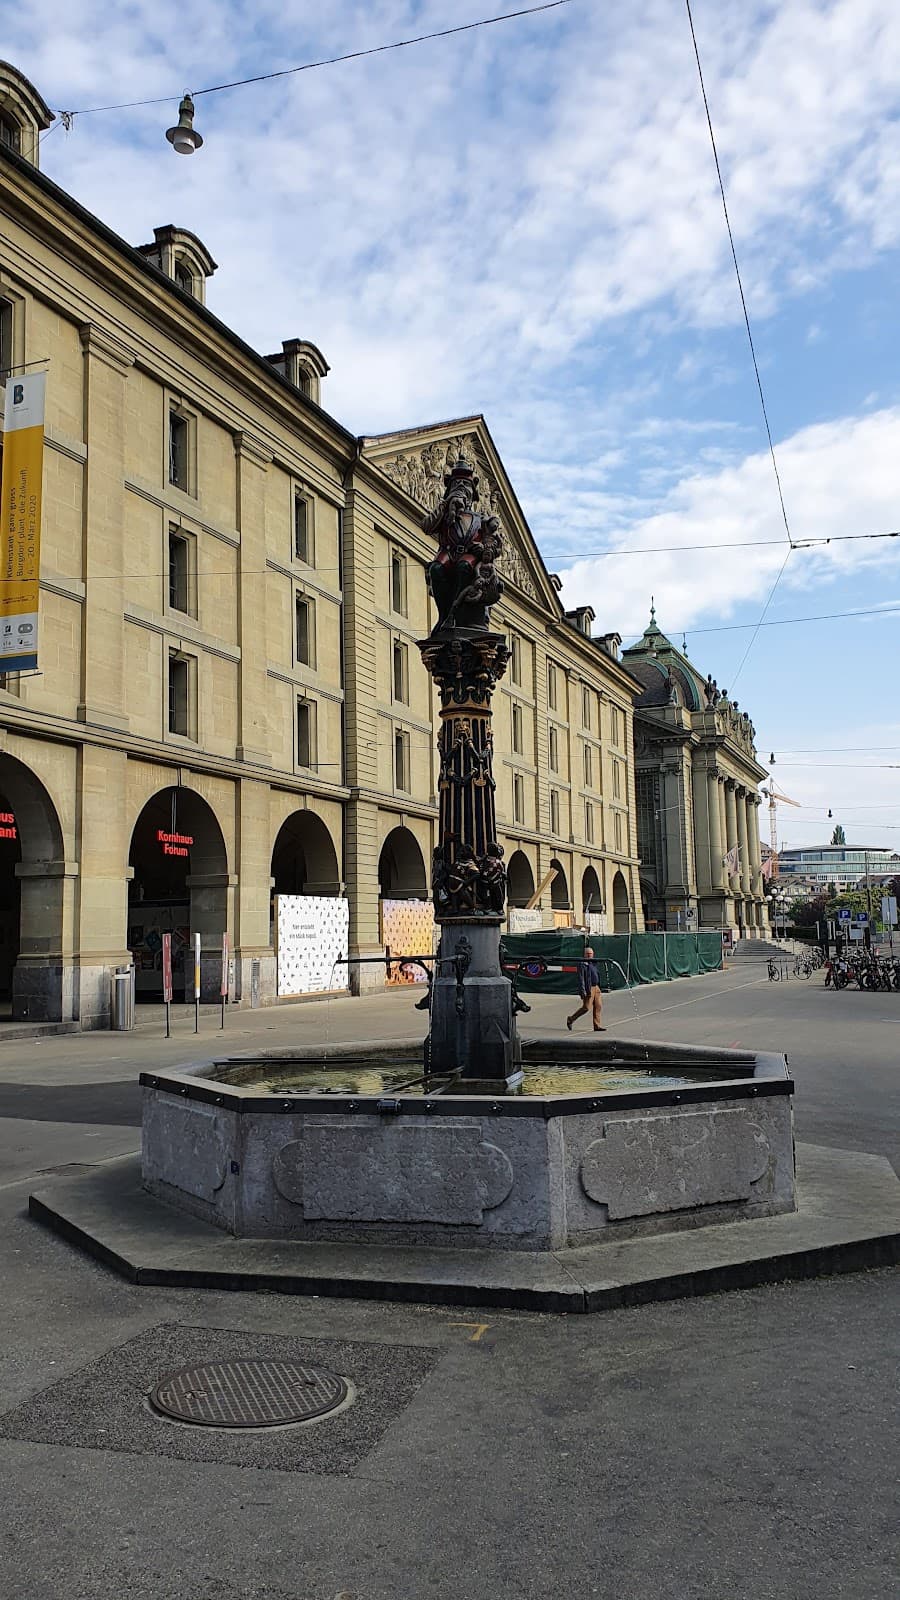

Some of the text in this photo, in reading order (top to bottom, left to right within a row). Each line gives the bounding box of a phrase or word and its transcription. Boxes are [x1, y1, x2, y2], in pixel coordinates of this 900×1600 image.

[14, 385, 24, 405] B
[17, 541, 25, 577] Burgdorf
[0, 813, 14, 823] us
[158, 830, 194, 844] Kornhaus
[164, 843, 188, 856] Forum
